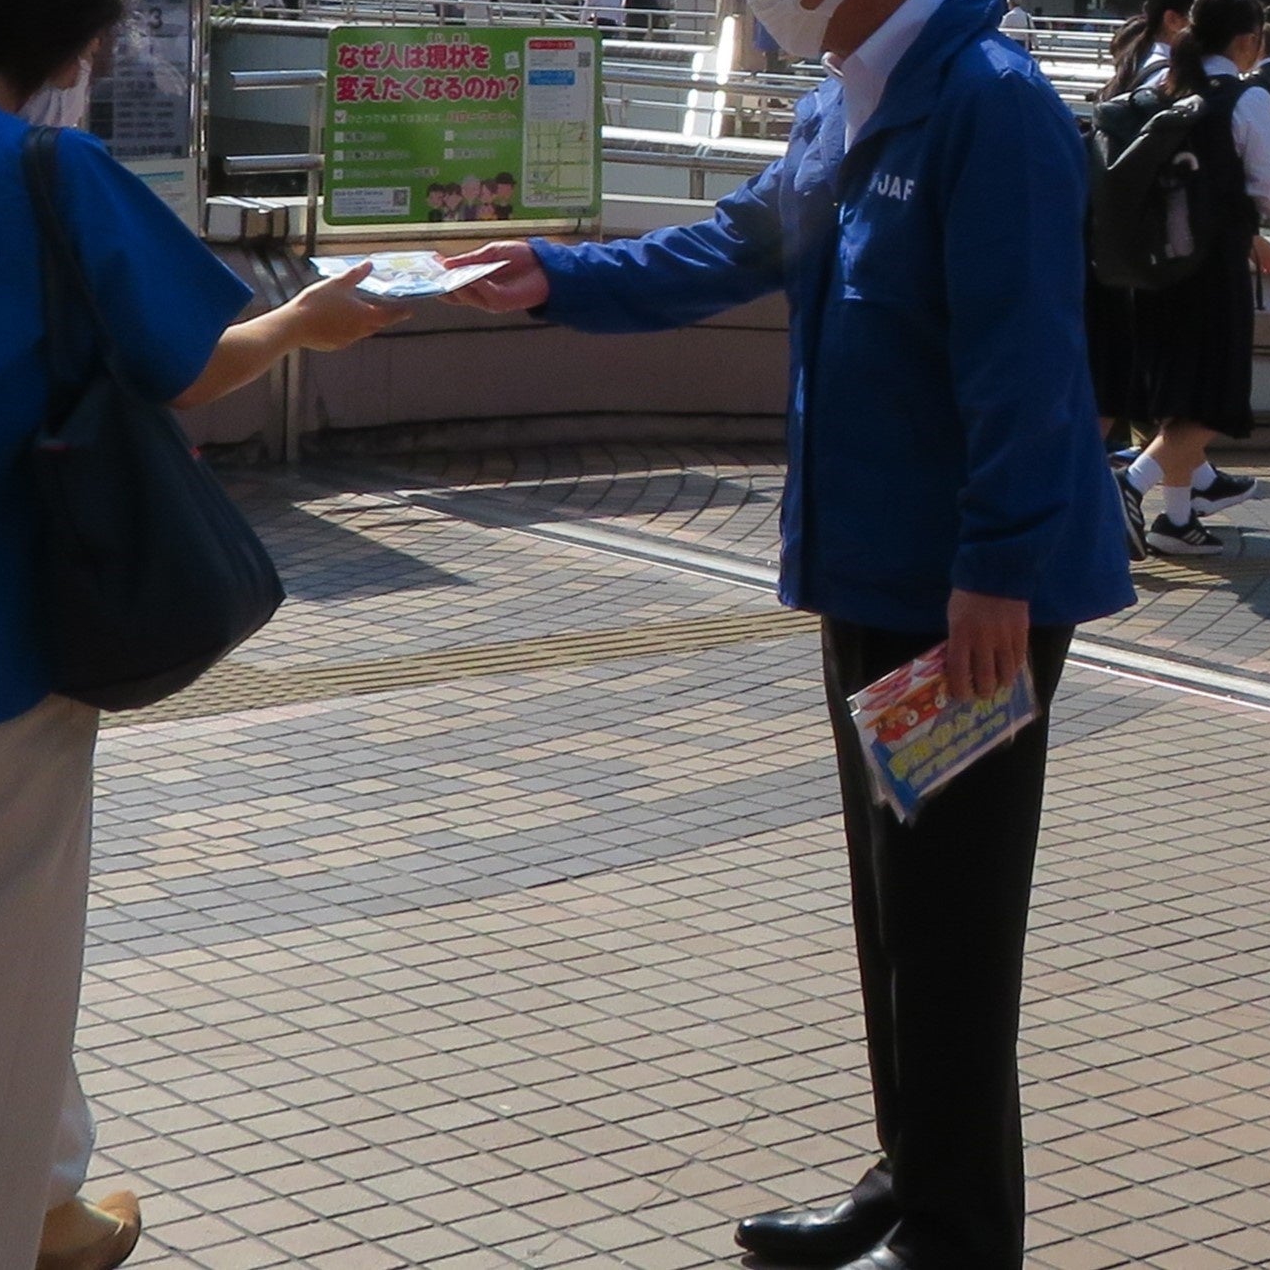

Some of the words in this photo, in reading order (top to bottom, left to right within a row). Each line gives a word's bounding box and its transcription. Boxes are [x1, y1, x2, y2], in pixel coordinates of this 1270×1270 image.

[149, 6, 163, 30] 3
[336, 42, 491, 71] なぜ人は現状を
[878, 174, 915, 202] JAF
